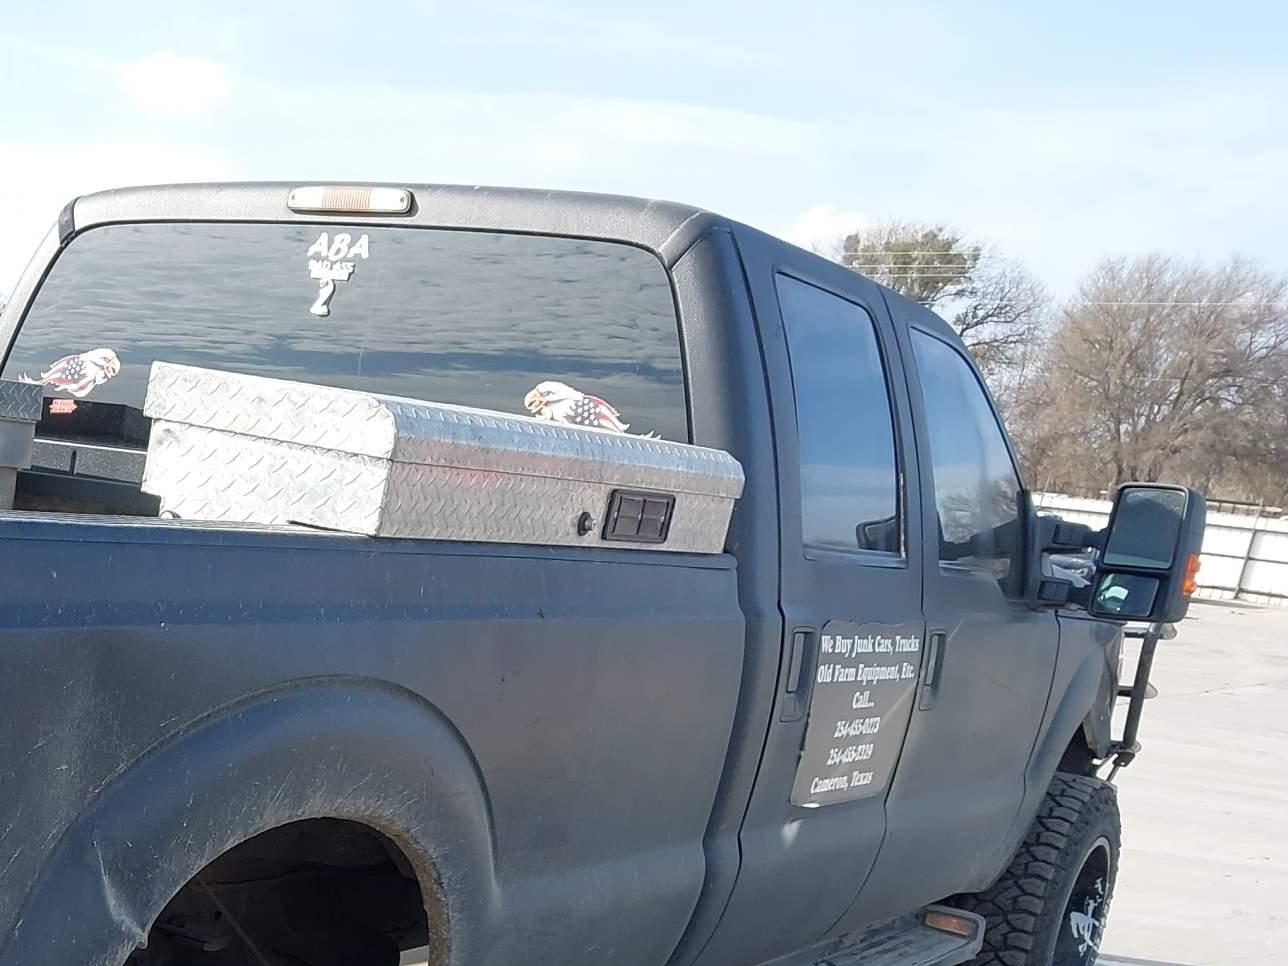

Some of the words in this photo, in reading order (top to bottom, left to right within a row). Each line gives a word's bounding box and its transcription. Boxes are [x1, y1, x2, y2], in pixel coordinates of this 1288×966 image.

[307, 232, 369, 260] ABA
[821, 635, 834, 654] We
[834, 635, 853, 658] Buy
[852, 634, 874, 658] Junk
[874, 635, 894, 656] Cars,
[895, 634, 920, 652] Trucks
[817, 664, 834, 683] Old
[833, 664, 856, 682] Farm
[856, 663, 900, 685] Equipment,
[810, 776, 849, 794] Cameron,
[851, 772, 873, 786] Texas
